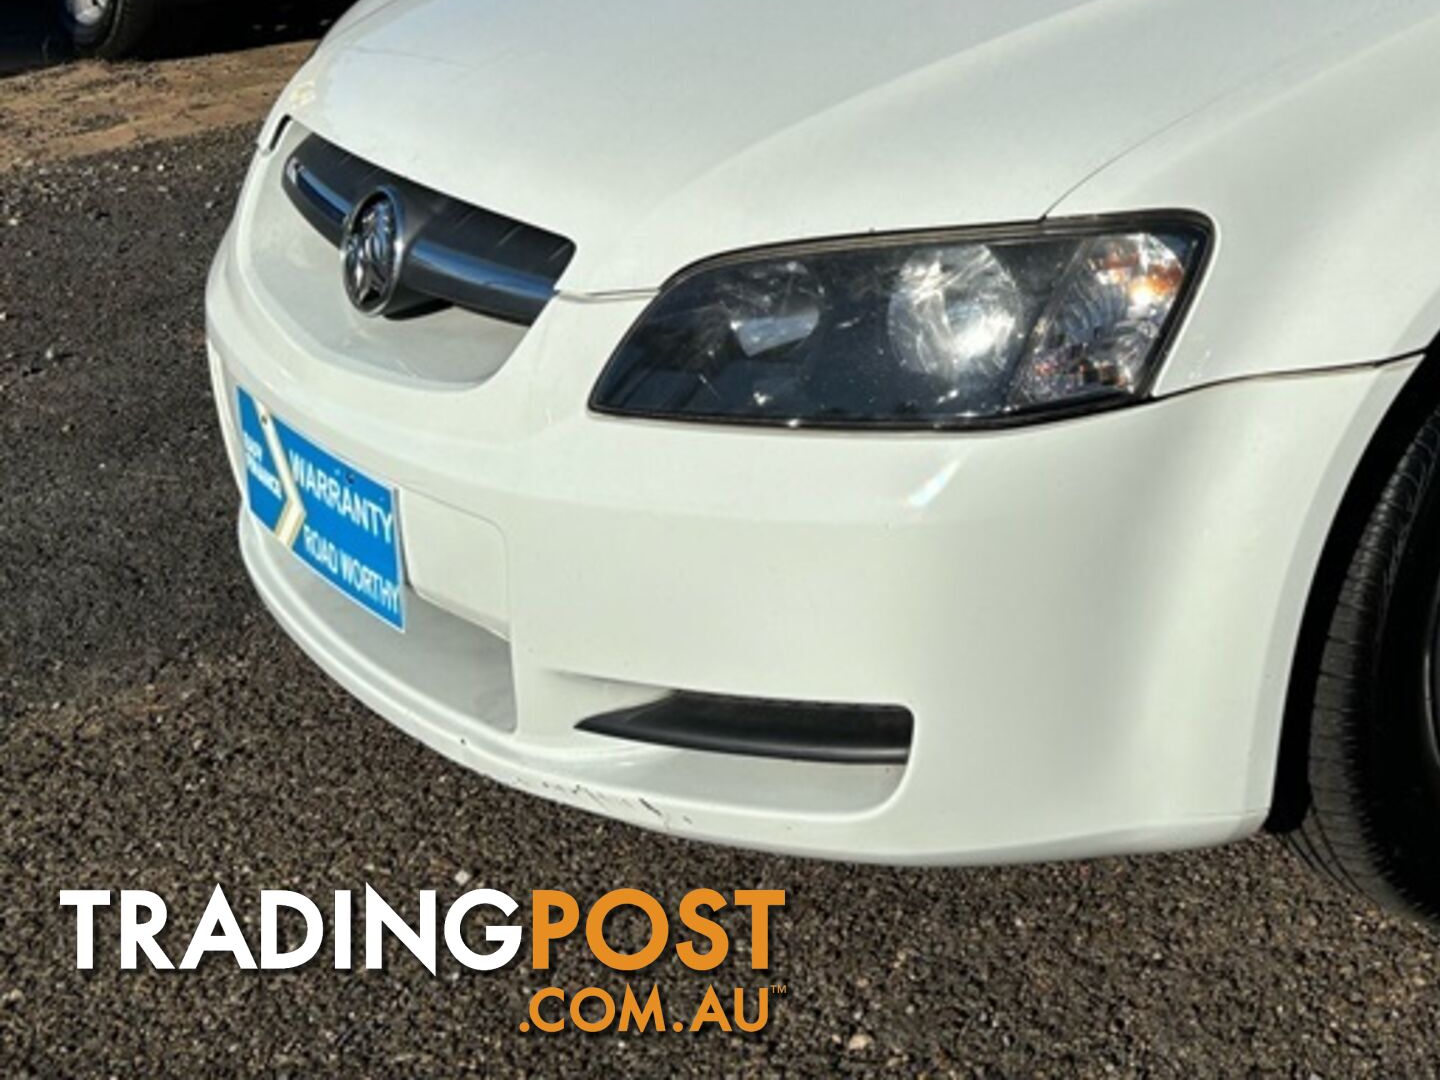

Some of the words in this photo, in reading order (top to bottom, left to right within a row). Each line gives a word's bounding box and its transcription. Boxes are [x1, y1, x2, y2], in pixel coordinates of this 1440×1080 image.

[289, 448, 393, 544] WARRANTY
[303, 525, 339, 573] ROAD
[340, 549, 401, 614] WORTHY
